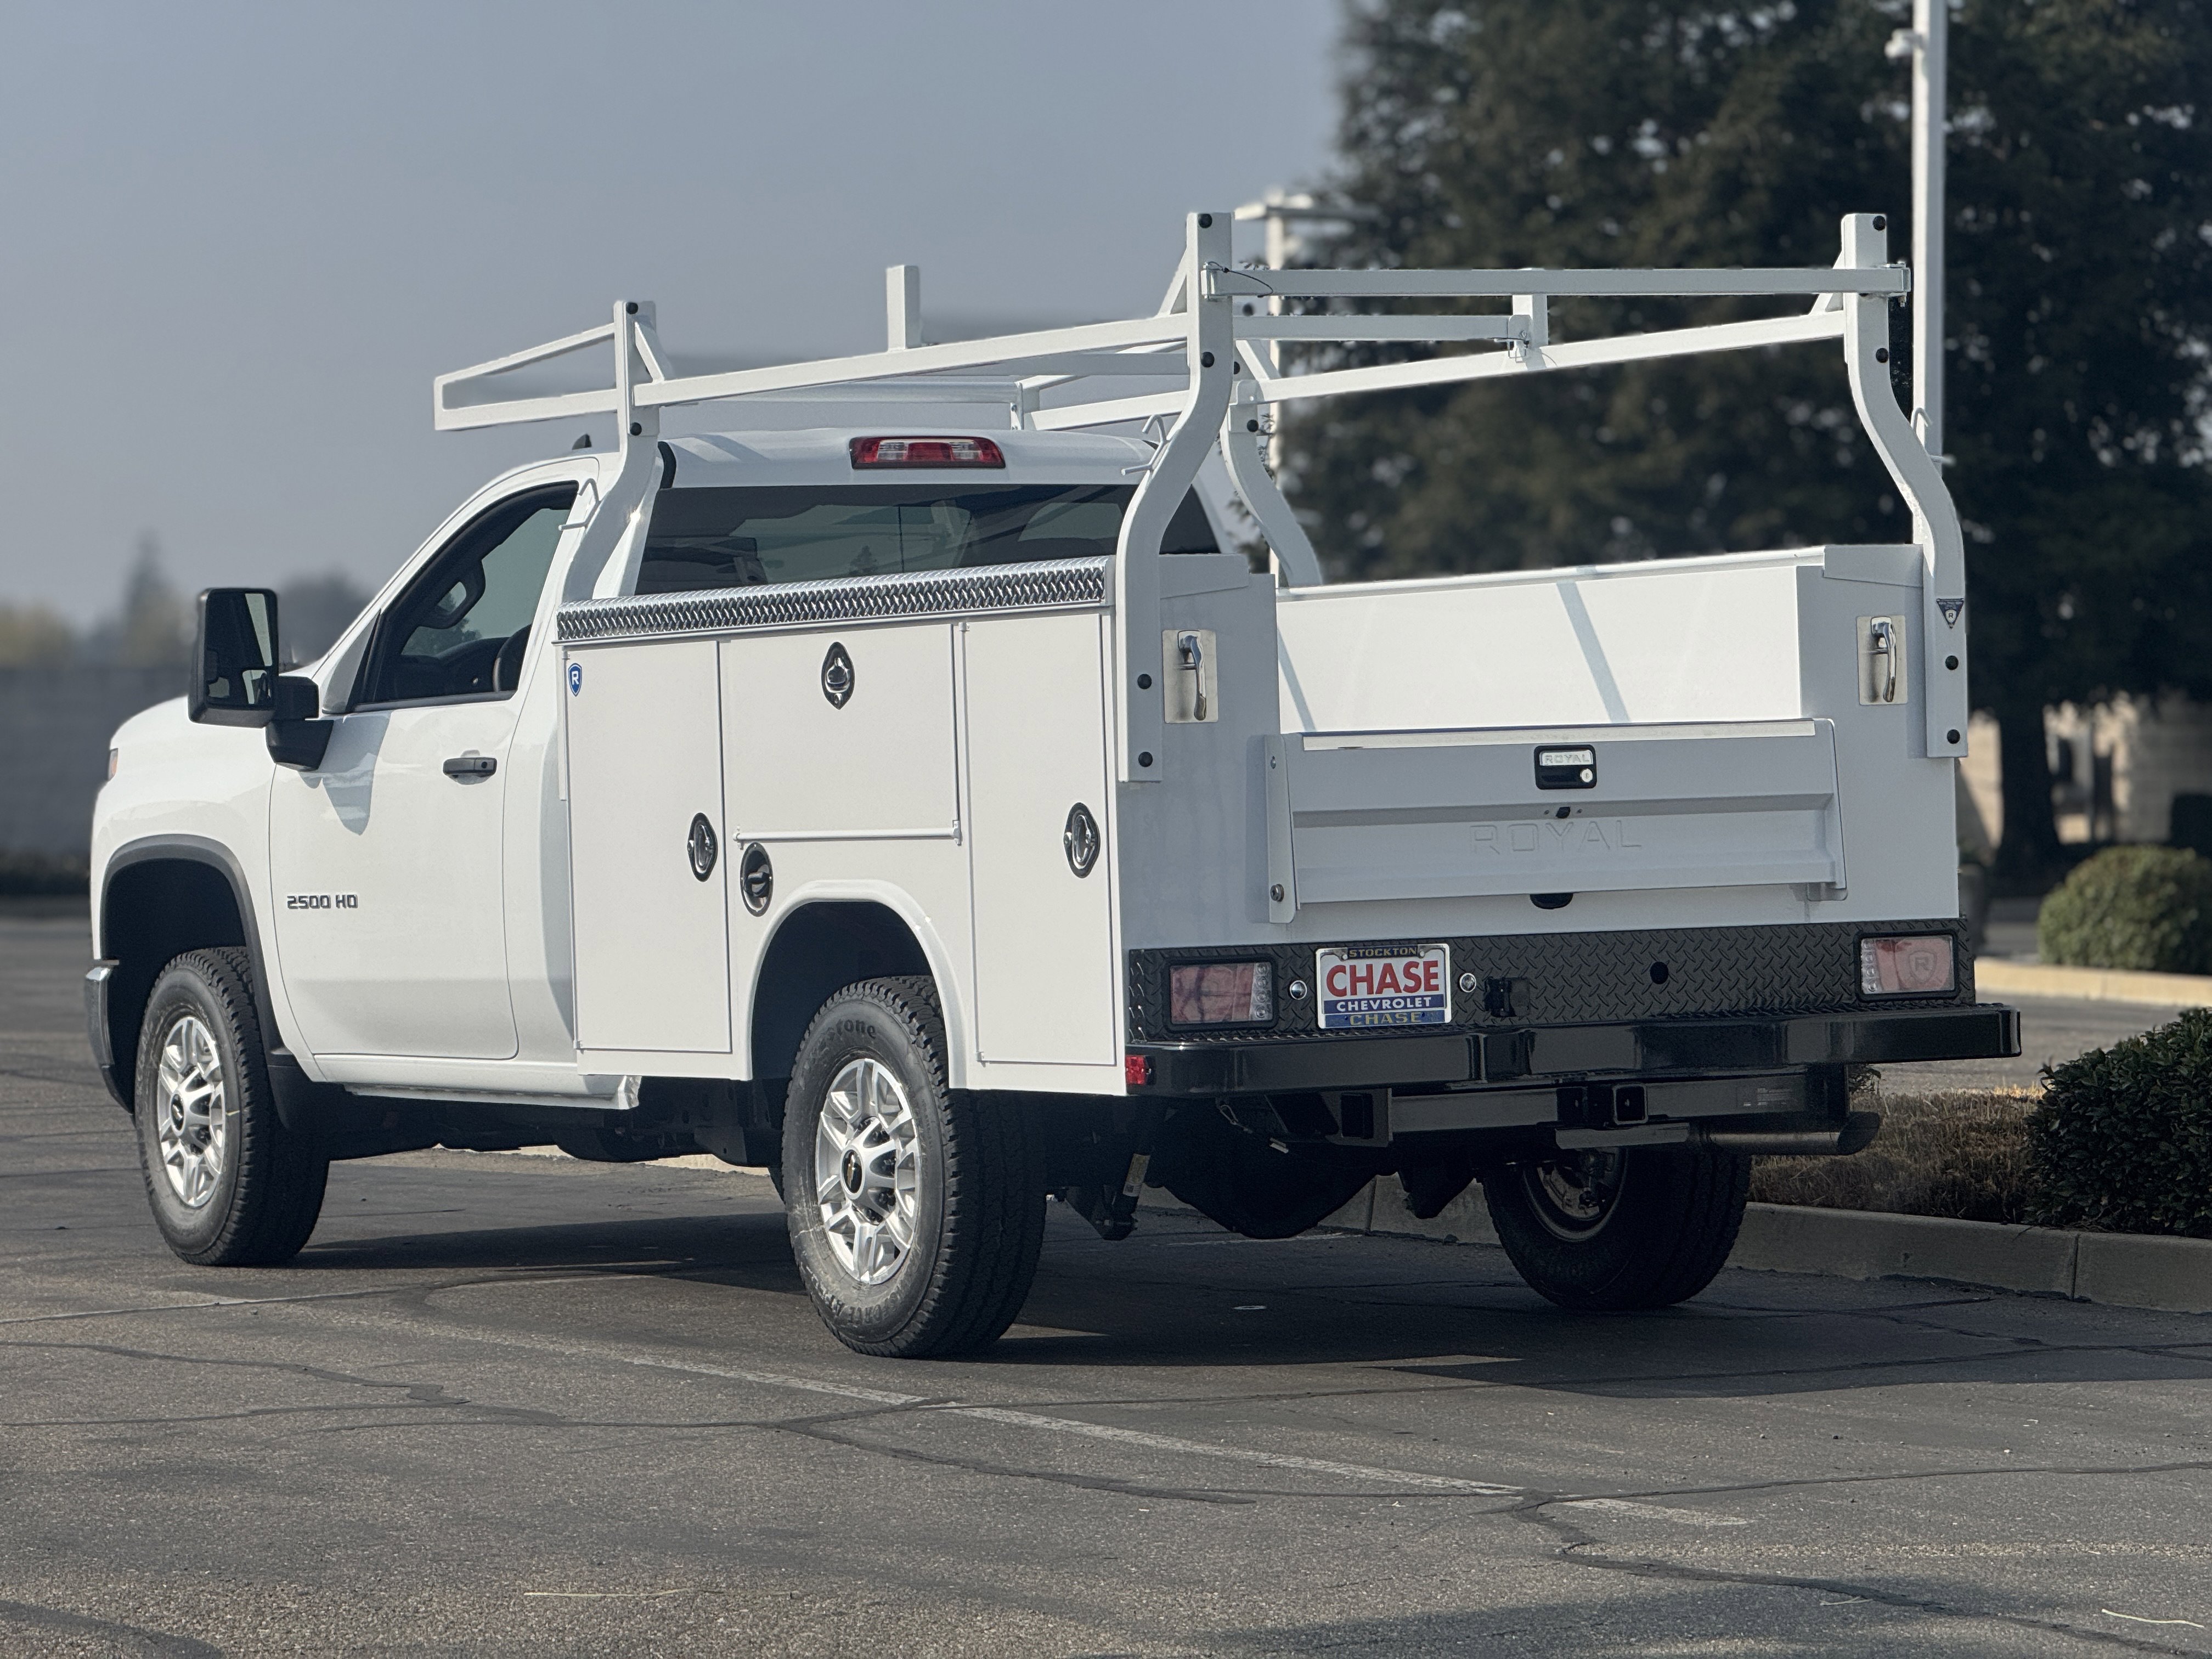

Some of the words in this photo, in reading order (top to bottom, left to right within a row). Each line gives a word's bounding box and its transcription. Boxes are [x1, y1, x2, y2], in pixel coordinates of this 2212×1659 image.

[571, 670, 579, 685] R
[1544, 753, 1590, 764] ROYAL
[1469, 820, 1642, 855] ROYAL
[287, 894, 331, 909] 2500
[335, 894, 358, 909] HD
[1349, 947, 1418, 957] STOCKTON
[1326, 960, 1440, 997] CHASE
[1336, 996, 1432, 1012] CHEVROLET
[1350, 1012, 1423, 1025] CHASE
